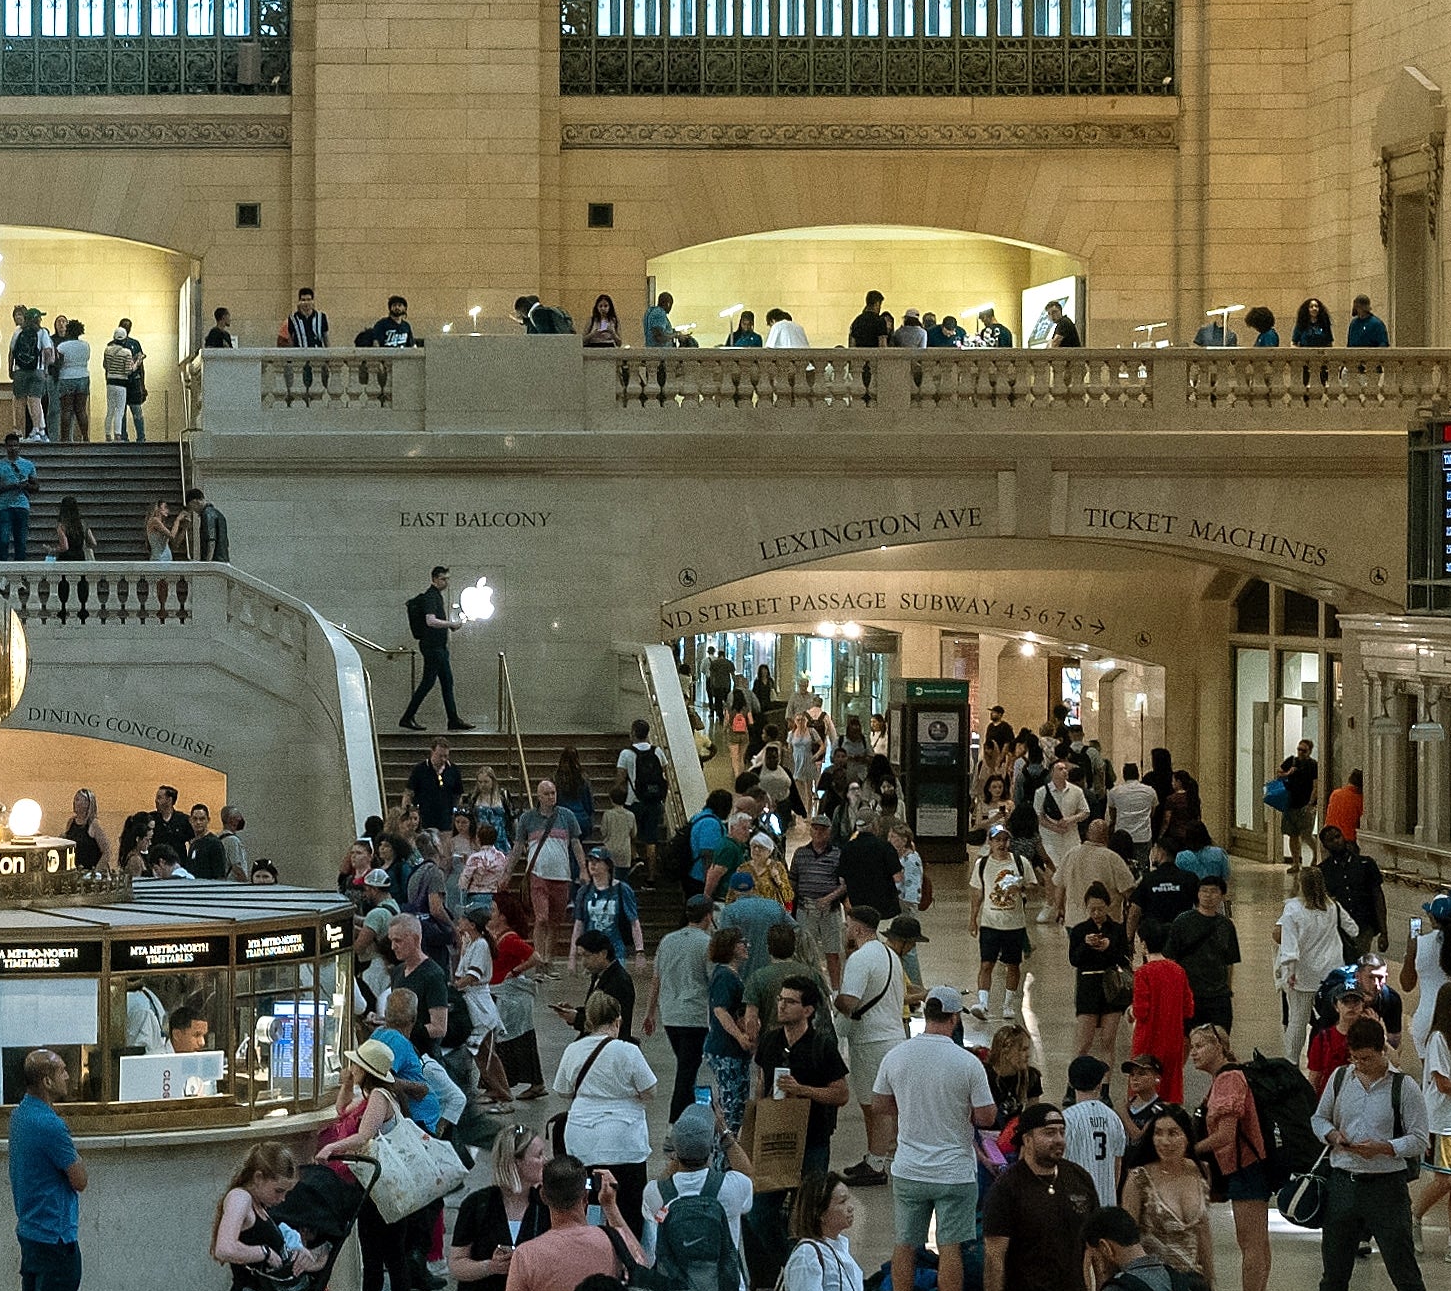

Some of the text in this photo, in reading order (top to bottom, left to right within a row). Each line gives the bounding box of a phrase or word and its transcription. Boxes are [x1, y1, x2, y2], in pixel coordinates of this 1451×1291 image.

[399, 511, 552, 528] EAST BALCONY
[759, 507, 983, 562] LEXINGTON AVE
[1084, 508, 1329, 567] TICKET MACHINES
[698, 592, 997, 624] STREET PASSAGE SUBWAY
[27, 706, 215, 759] DINING CONCOURSE
[7, 948, 78, 958] METRO-NORTH
[130, 943, 209, 956] MTA METRO-NORTH
[3, 958, 60, 968] TIMETABLES
[146, 953, 194, 964] TIMETABLES
[1089, 1116, 1108, 1128] RUTH
[1092, 1130, 1107, 1161] 3
